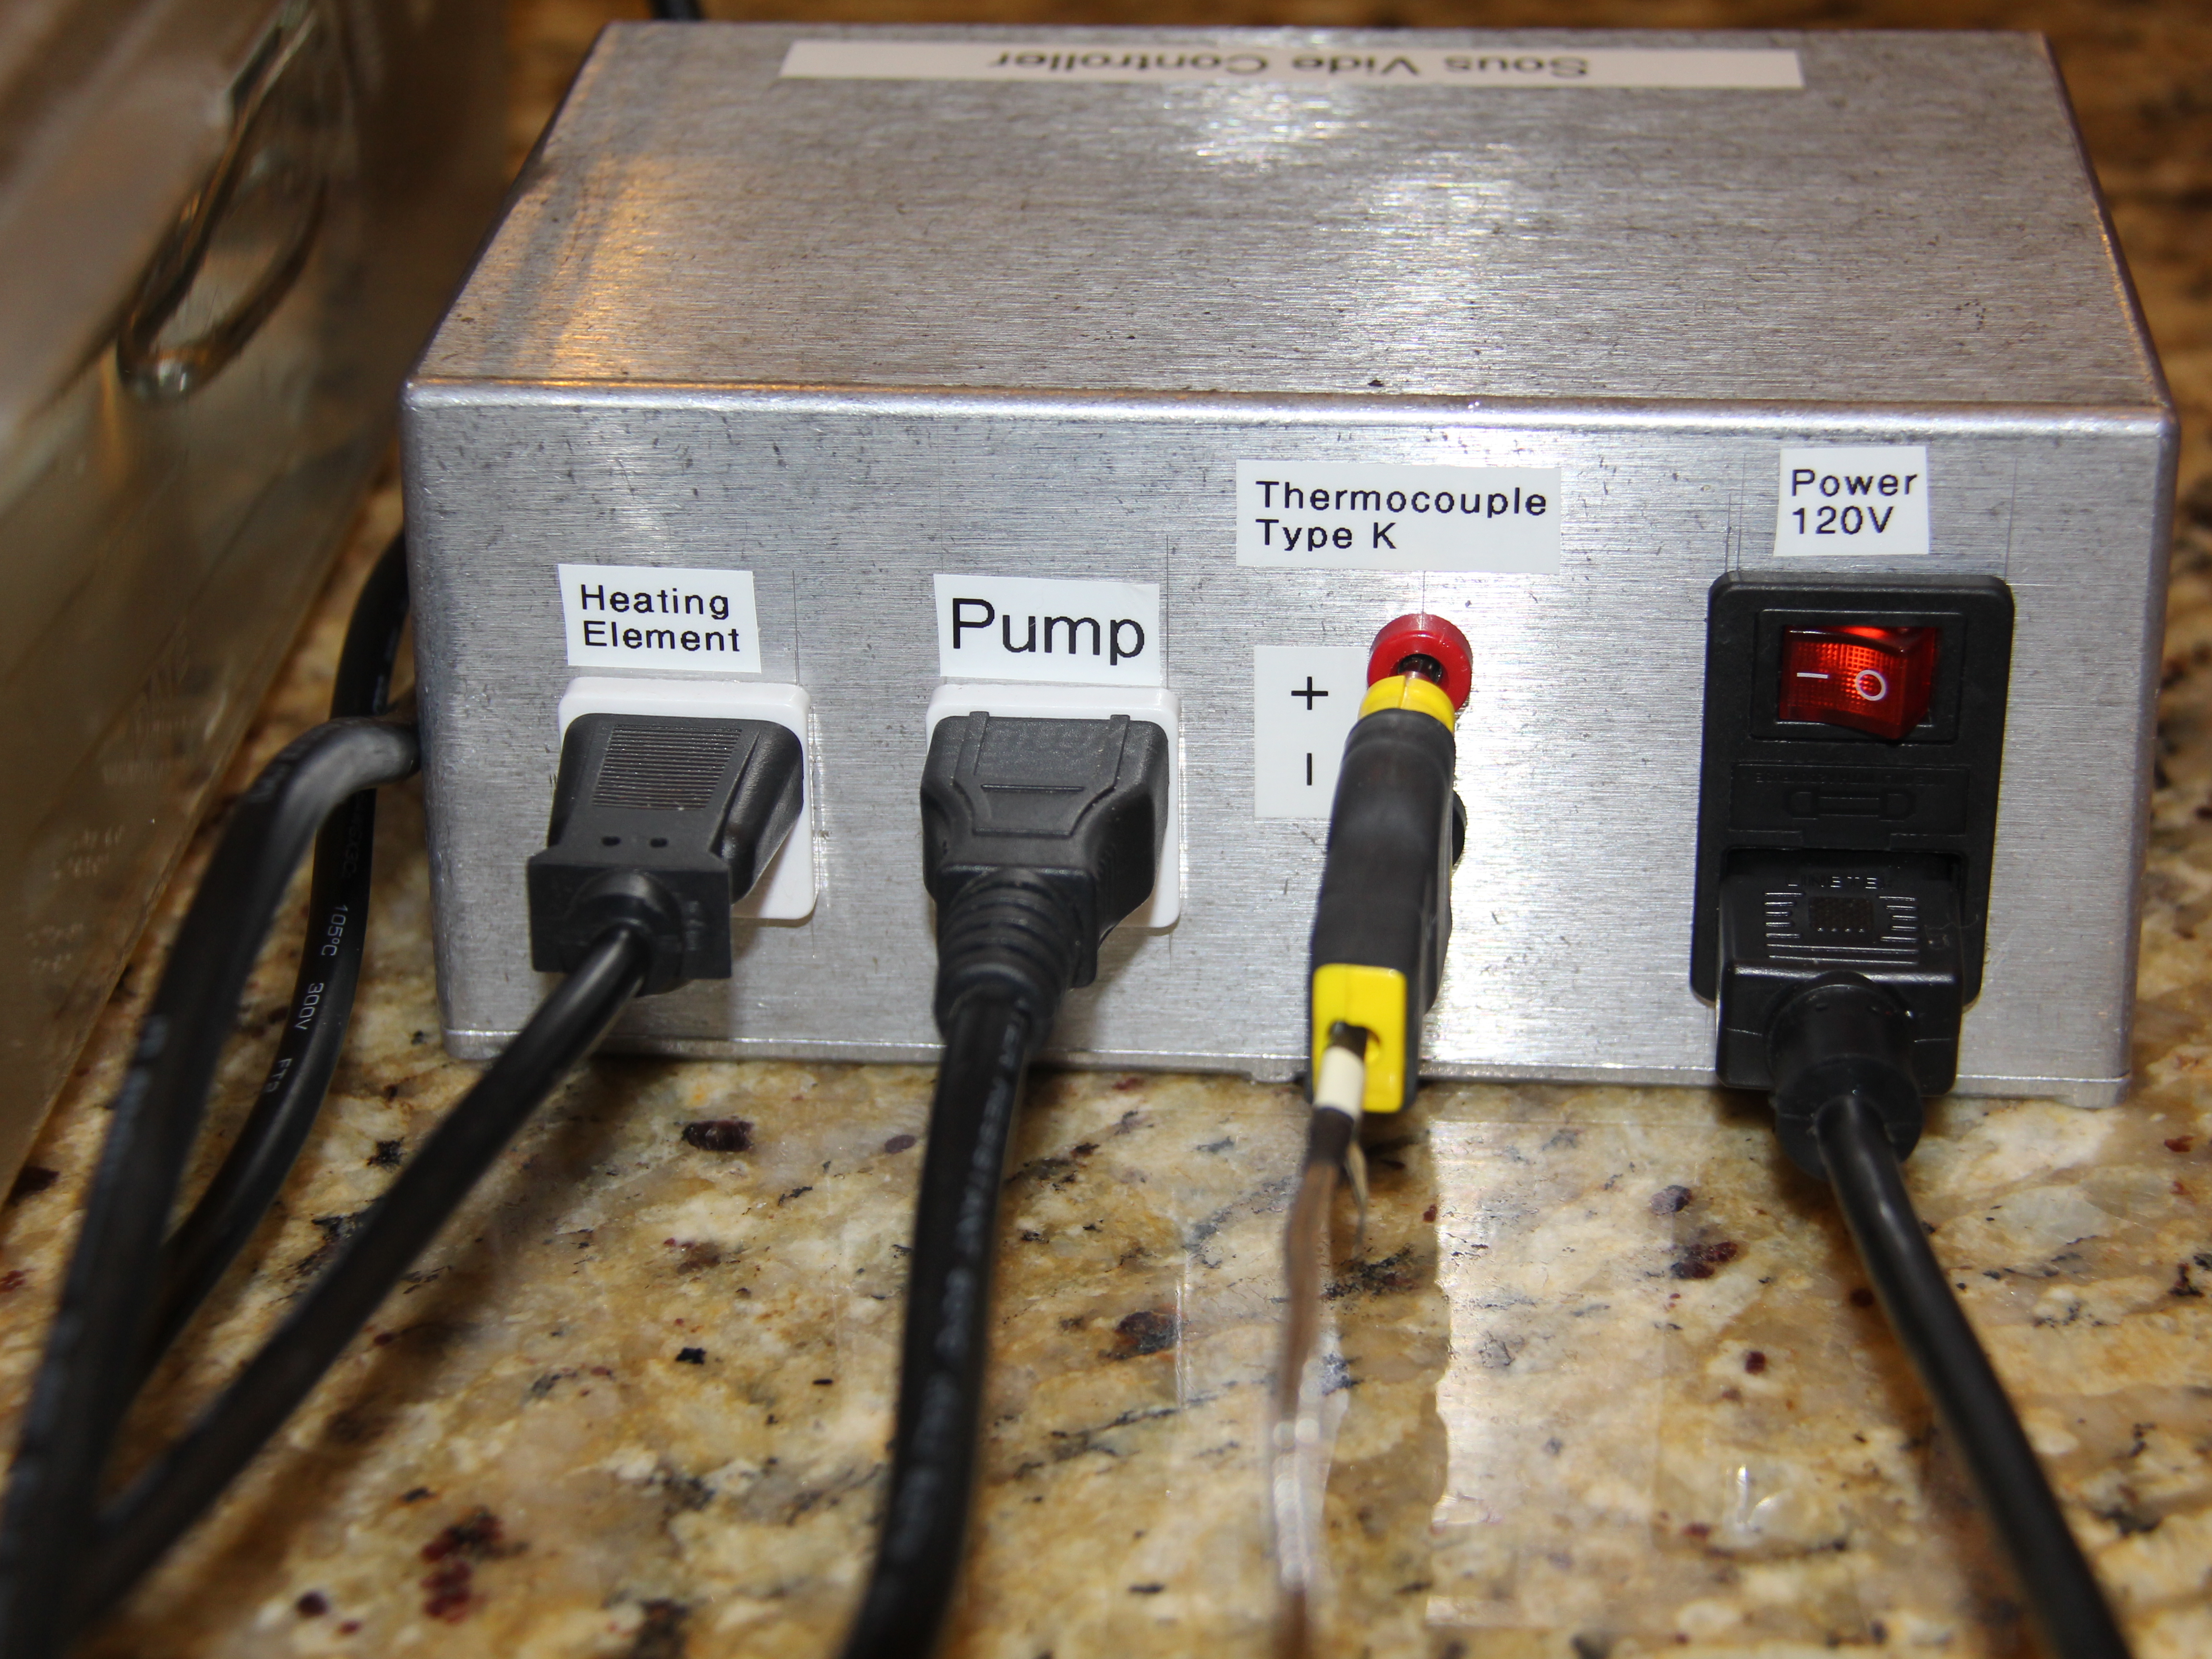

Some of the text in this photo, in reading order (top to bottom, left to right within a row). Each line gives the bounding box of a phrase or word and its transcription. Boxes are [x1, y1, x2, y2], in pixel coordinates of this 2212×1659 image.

[989, 52, 1587, 77] Sous Vide Controller
[1255, 481, 1547, 518] Thermocouple
[1791, 469, 1918, 497] Power
[1255, 518, 1397, 552] Type K
[1791, 505, 1894, 535] 120V
[580, 584, 729, 620] Heating
[583, 620, 740, 652] Element
[952, 598, 1145, 666] Pump
[294, 982, 324, 1030] 300V
